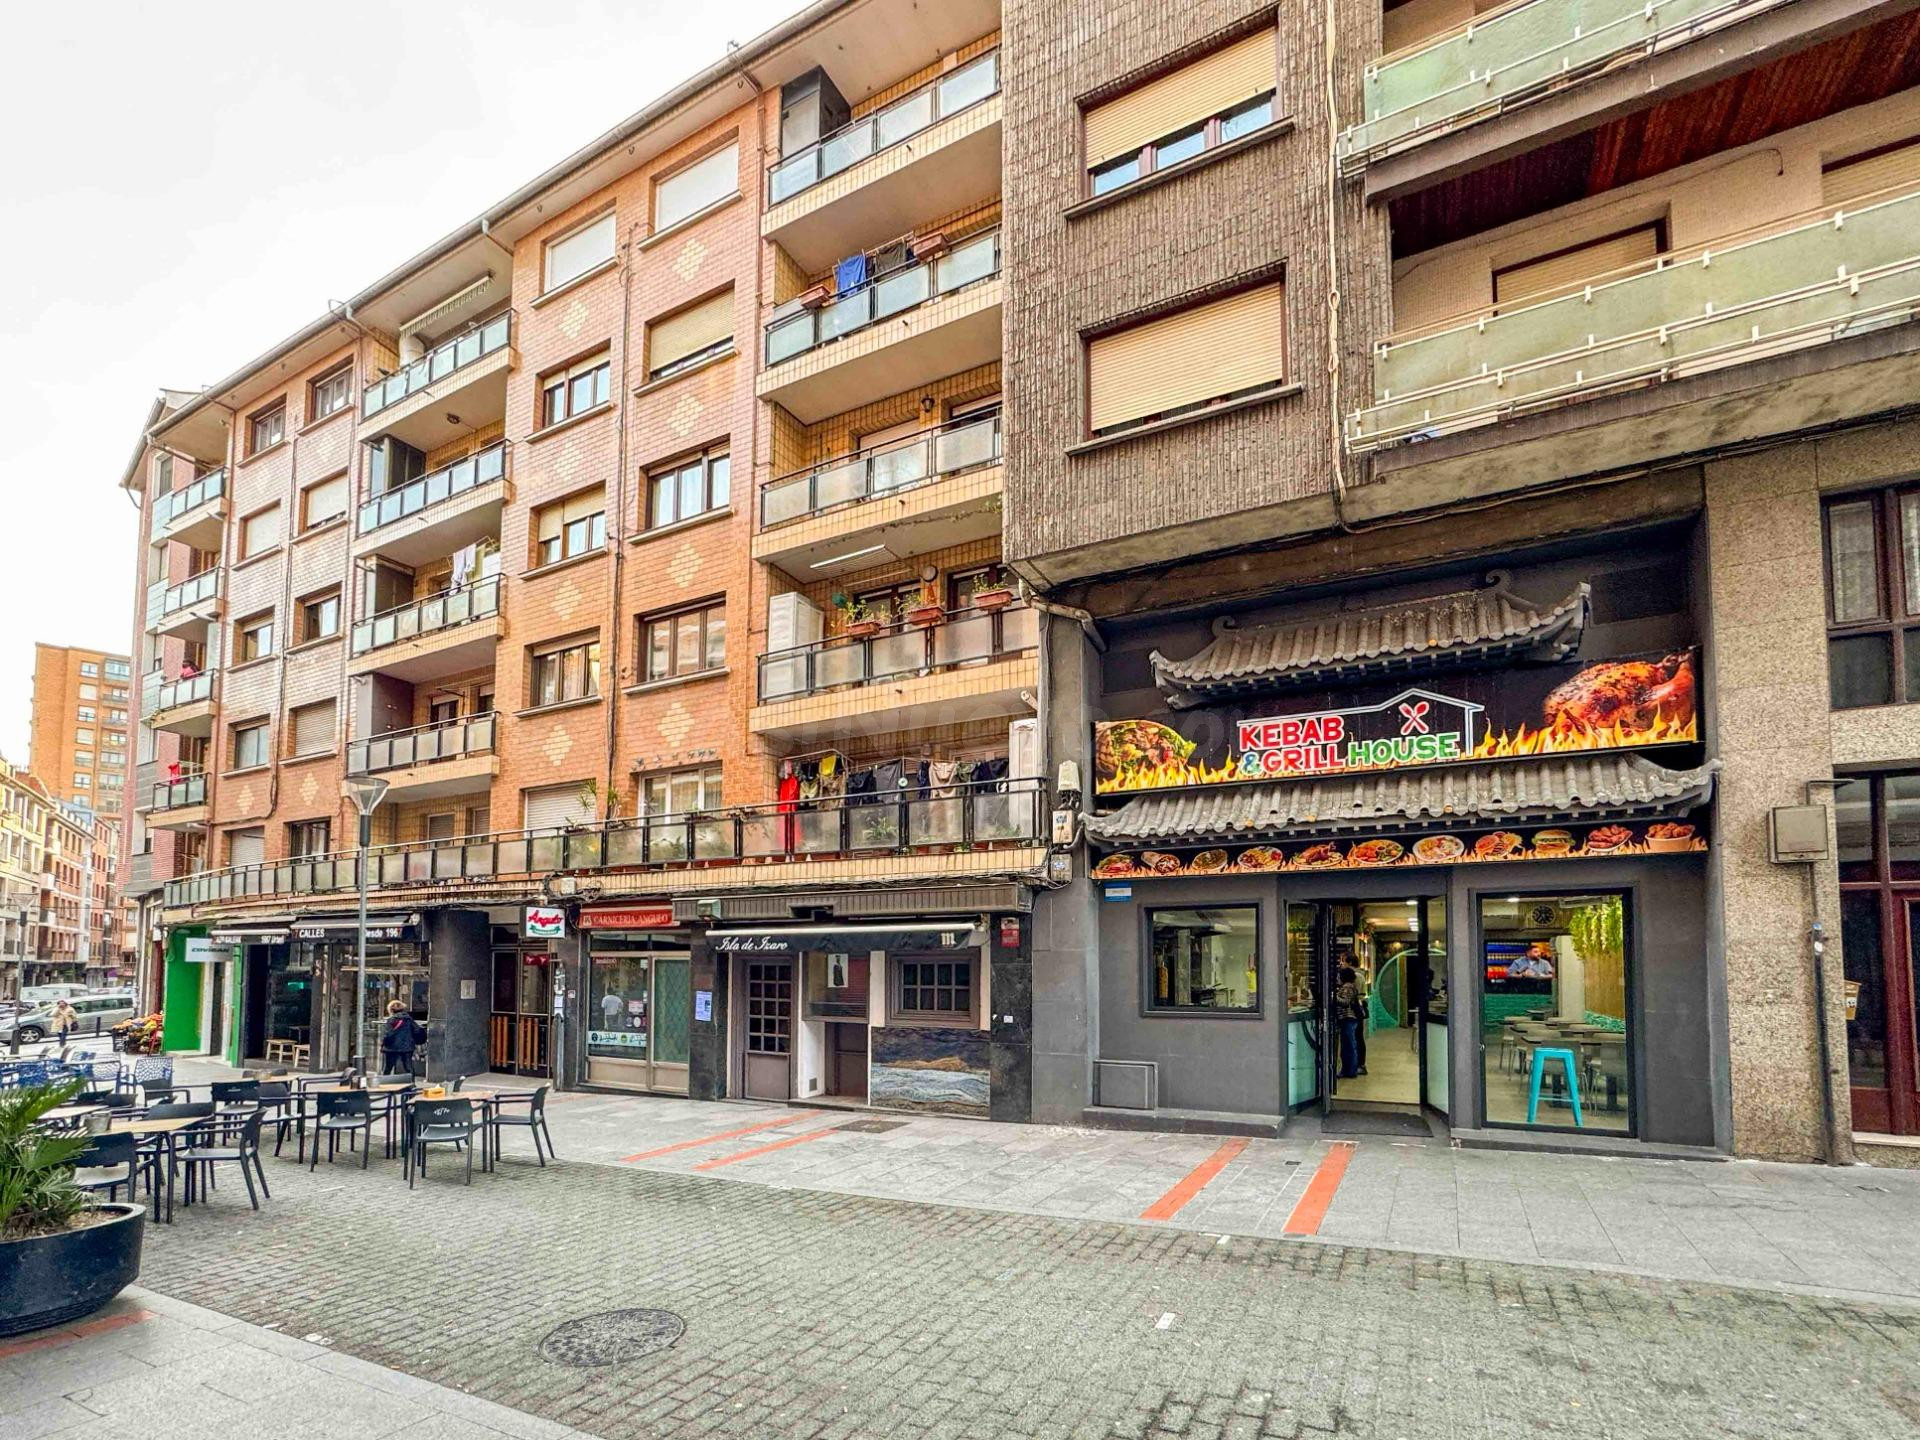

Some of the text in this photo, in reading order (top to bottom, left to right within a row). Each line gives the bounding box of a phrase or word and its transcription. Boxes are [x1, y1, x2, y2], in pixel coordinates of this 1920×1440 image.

[1240, 715, 1344, 751] KEBAB
[1348, 732, 1460, 766] HOUSE
[640, 913, 669, 925] ANGULO
[299, 928, 325, 939] CALLES
[715, 935, 788, 951] Isla de Izaro
